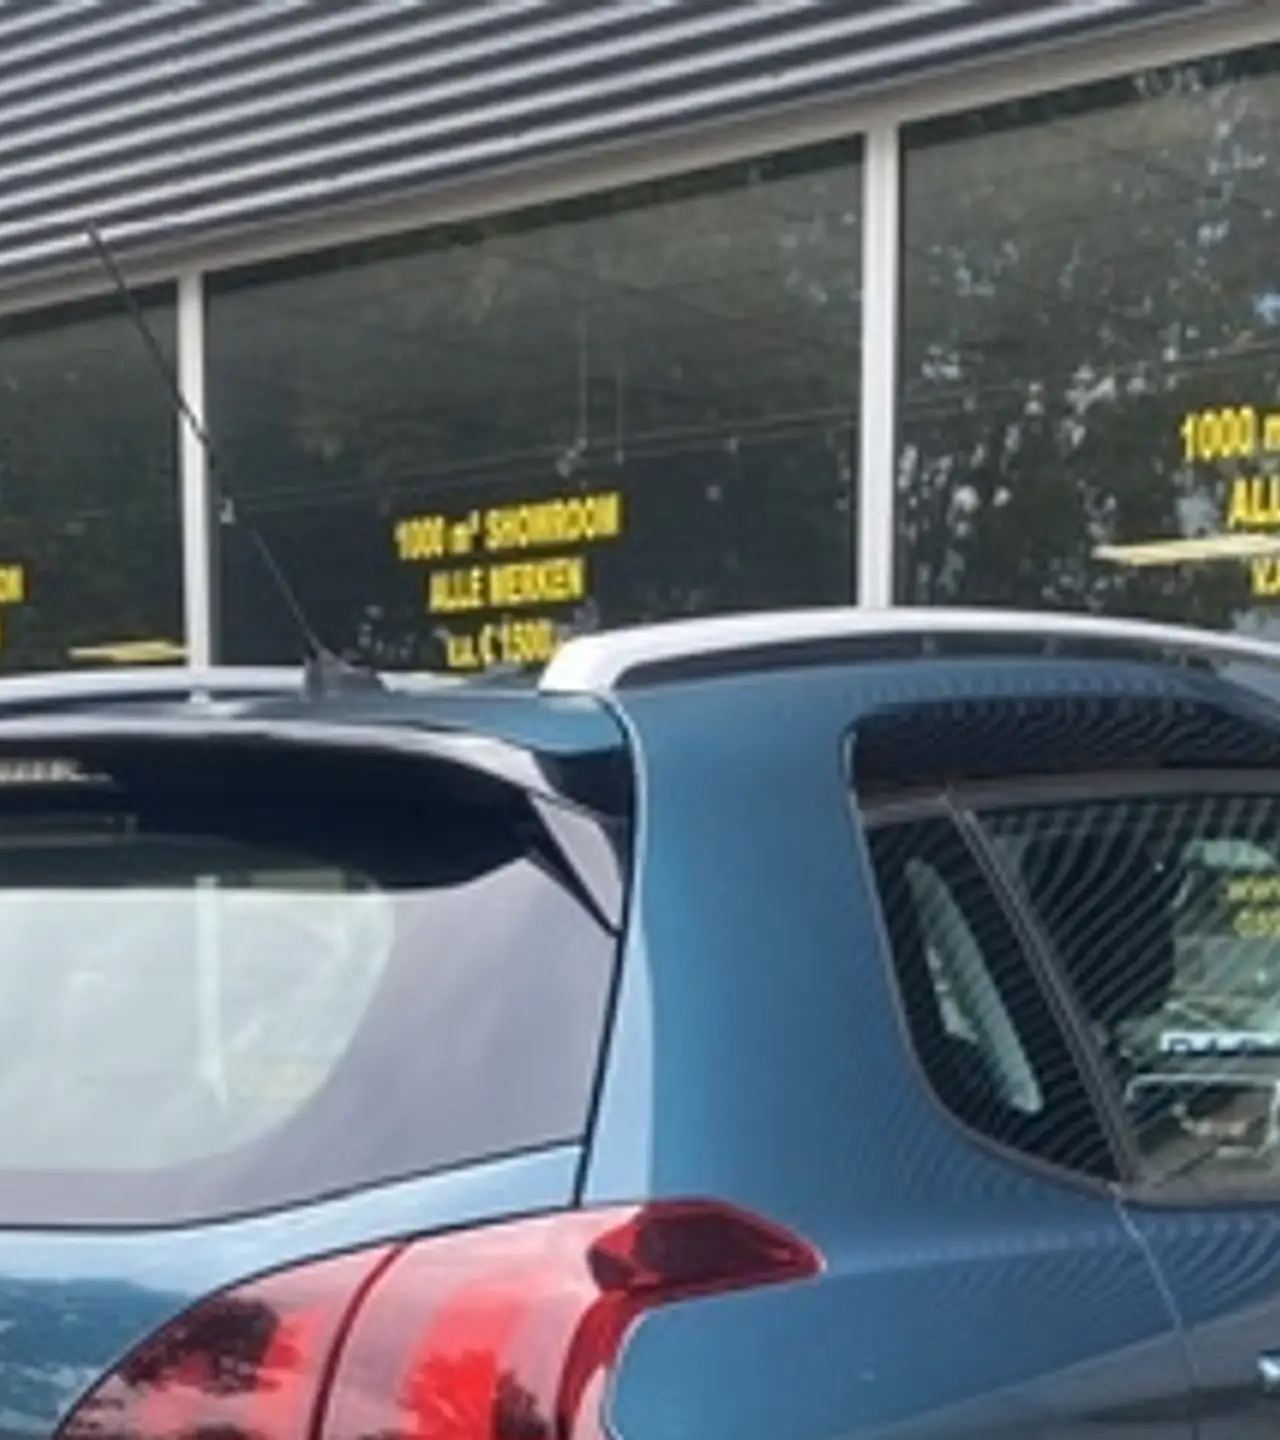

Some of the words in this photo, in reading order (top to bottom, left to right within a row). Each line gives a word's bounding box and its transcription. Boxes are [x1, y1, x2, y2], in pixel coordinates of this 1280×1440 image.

[1181, 404, 1257, 463] 1000
[484, 491, 621, 551] SHOWROOM
[428, 566, 486, 614] ALLE
[488, 555, 586, 608] MERKEN
